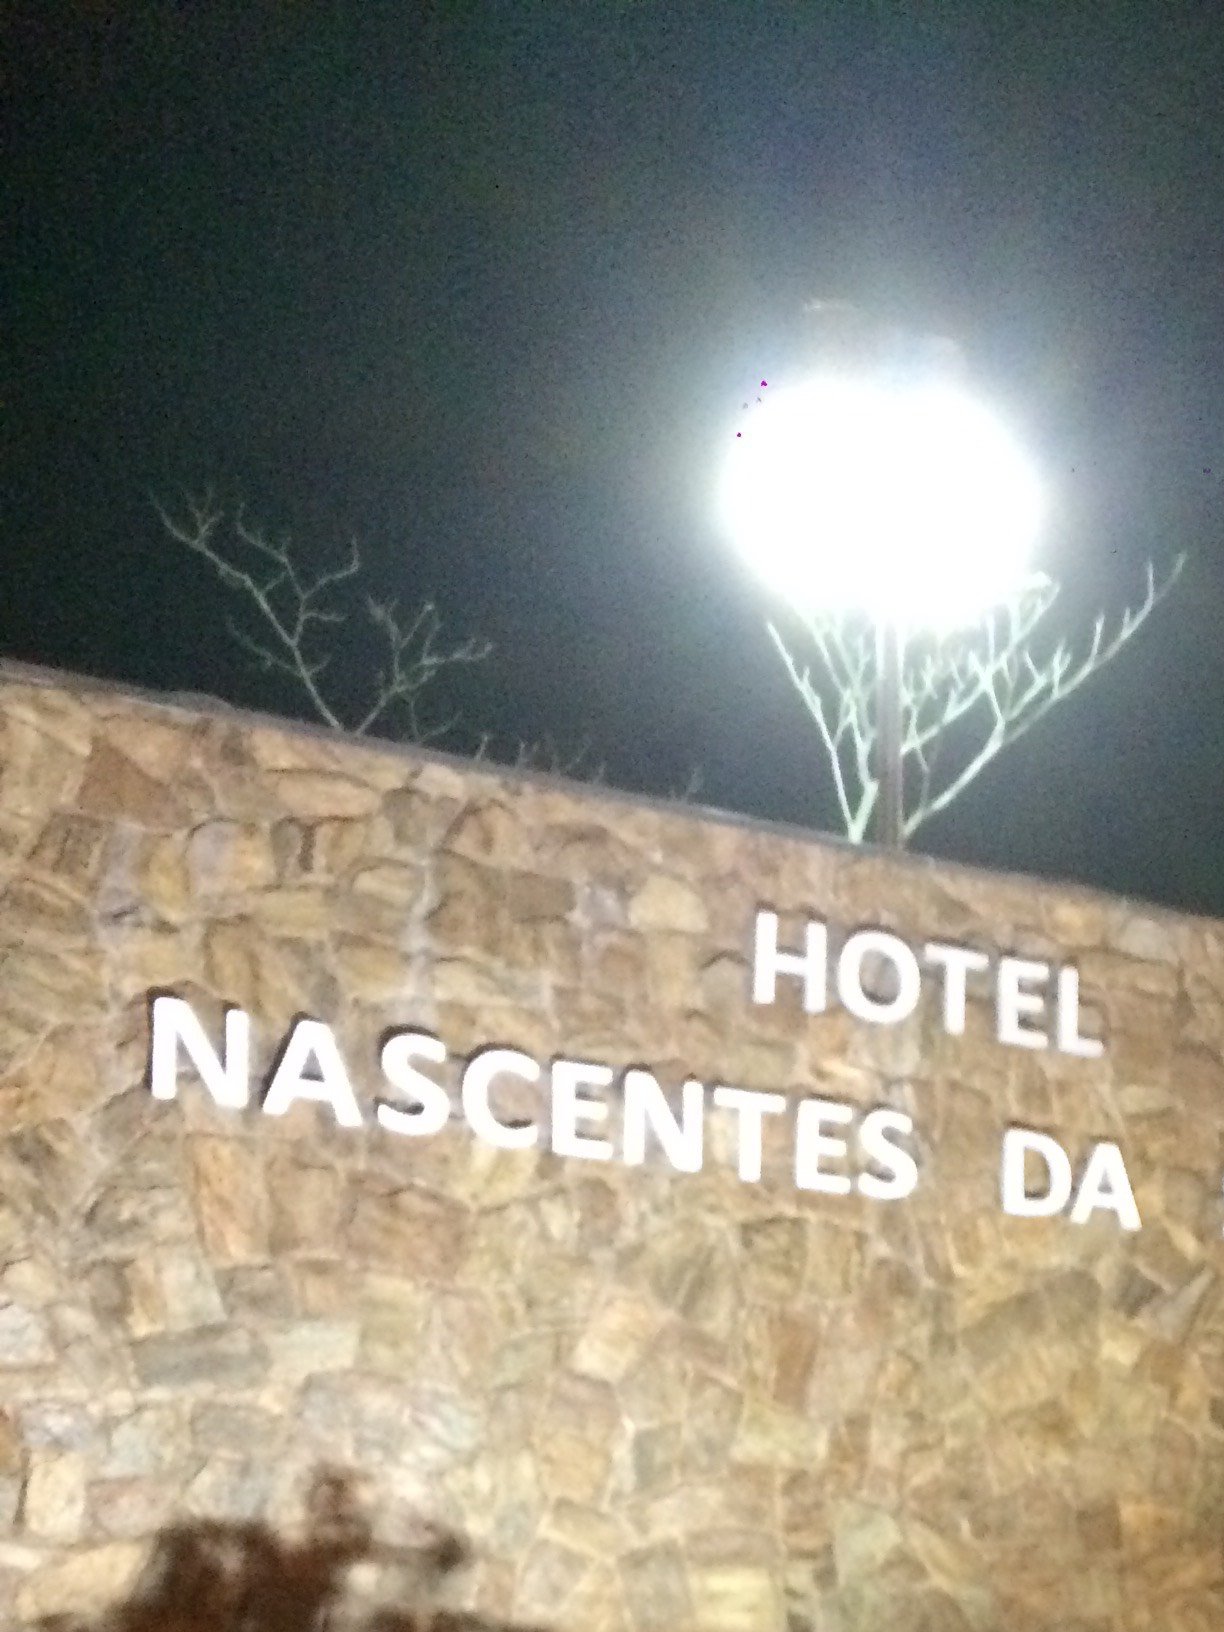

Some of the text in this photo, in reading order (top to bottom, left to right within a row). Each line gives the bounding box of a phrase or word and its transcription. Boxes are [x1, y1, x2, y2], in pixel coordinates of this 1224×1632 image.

[751, 910, 1105, 1059] HOTEL
[149, 994, 921, 1202] NASCENTES
[1001, 1126, 1143, 1233] DA
